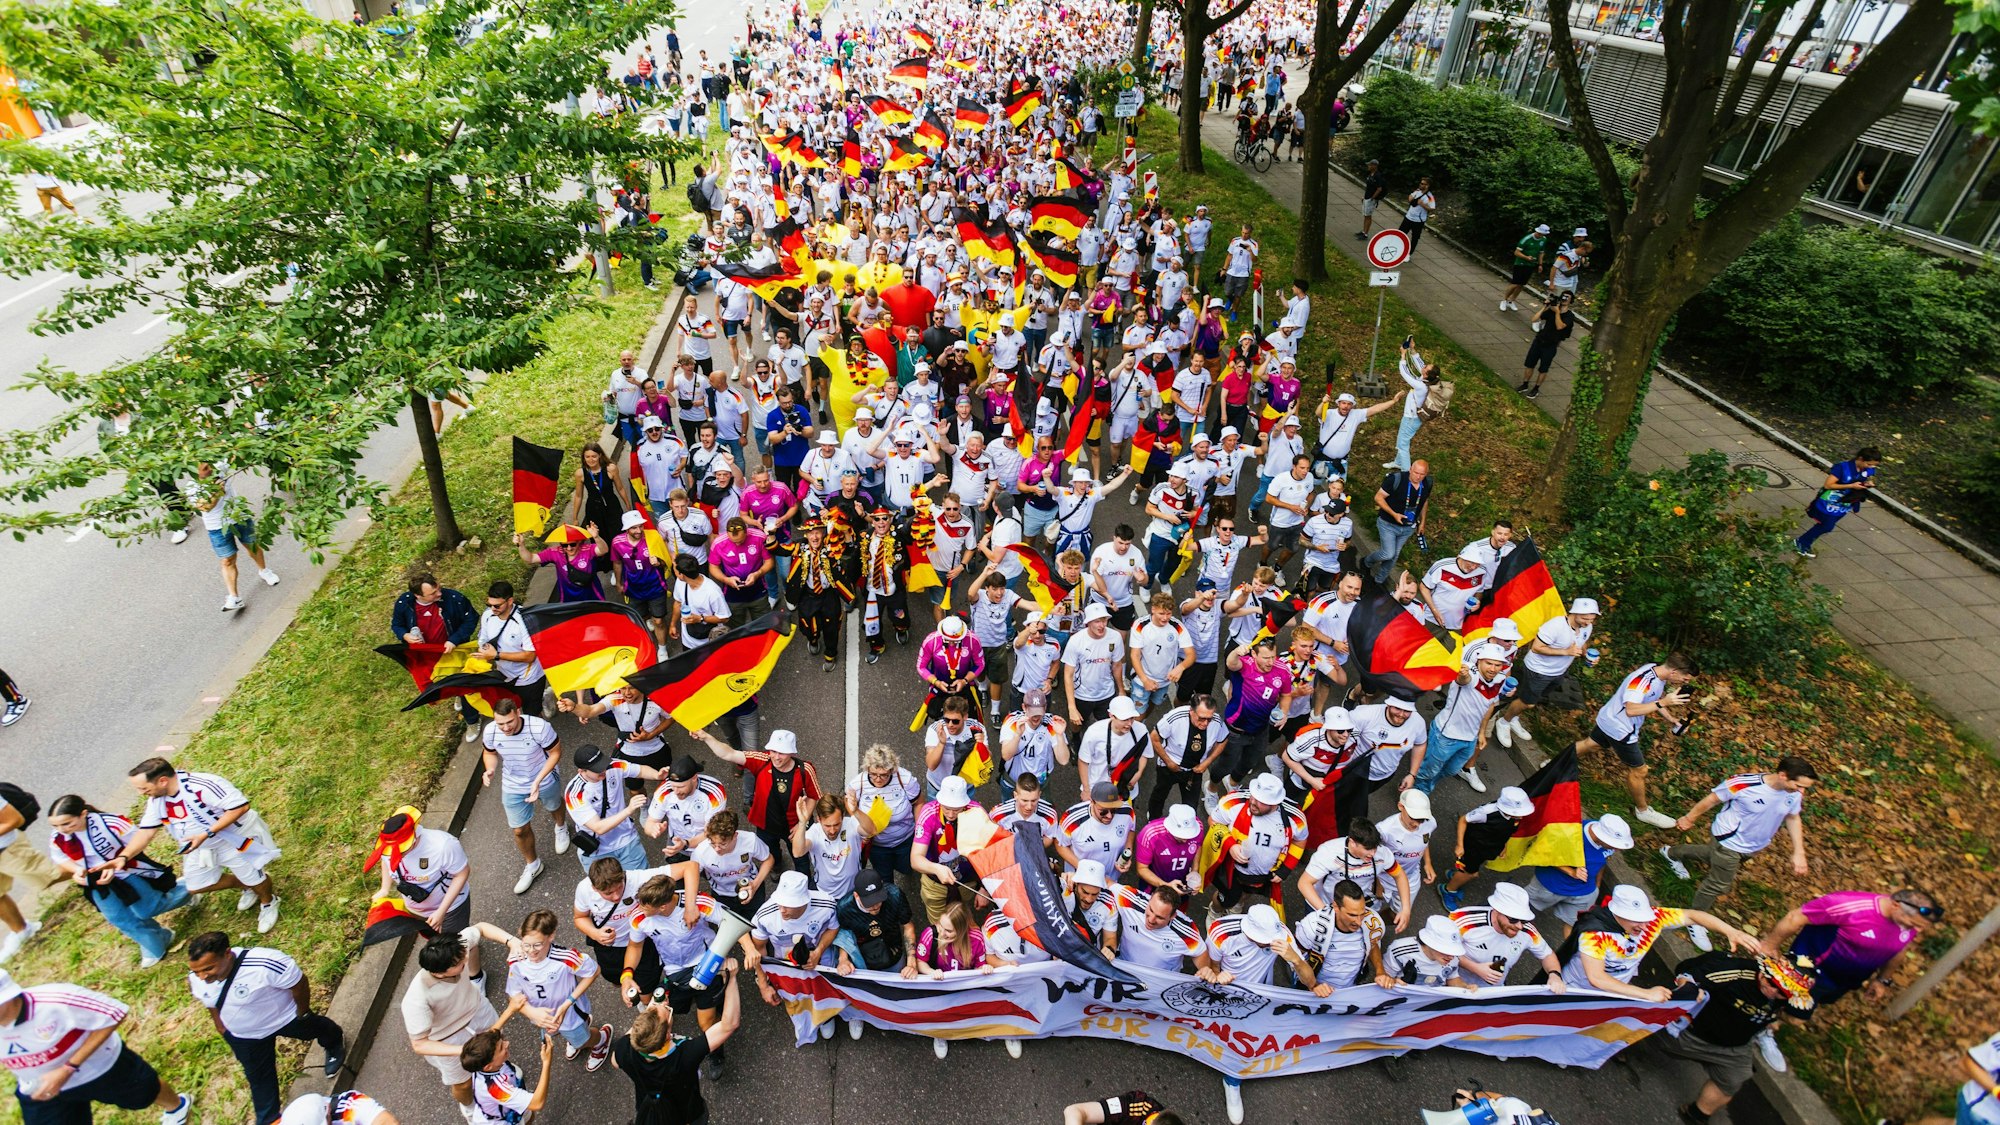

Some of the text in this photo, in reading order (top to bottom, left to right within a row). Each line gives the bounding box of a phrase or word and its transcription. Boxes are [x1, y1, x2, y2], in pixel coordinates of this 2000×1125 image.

[900, 473, 909, 484] 11
[1156, 644, 1162, 655] 7
[683, 814, 692, 826] 5
[1255, 832, 1271, 847] 13
[1103, 841, 1110, 852] 9
[1171, 857, 1188, 871] 13
[536, 984, 547, 998] 2
[1041, 976, 1151, 1004] WIR
